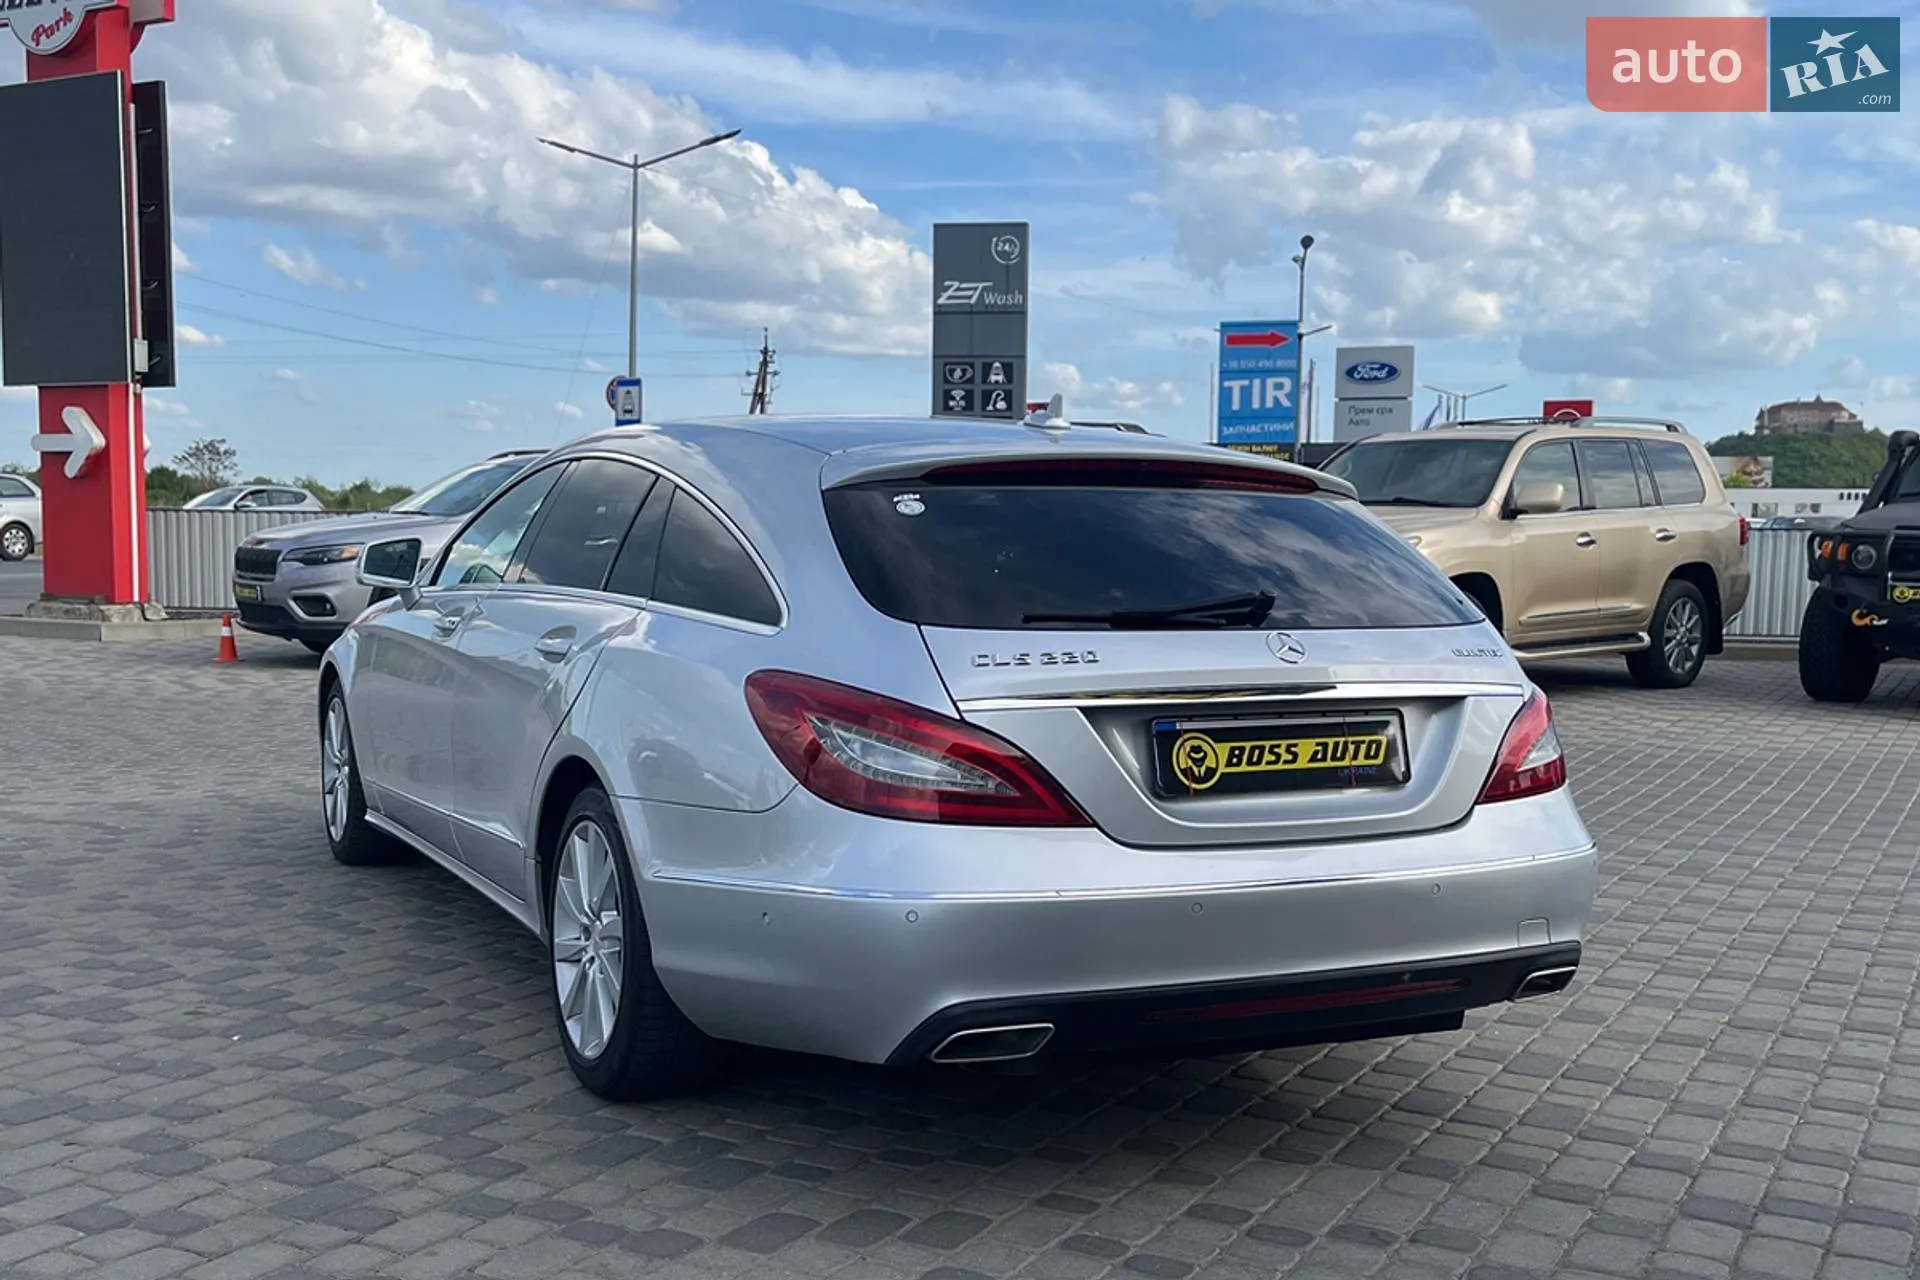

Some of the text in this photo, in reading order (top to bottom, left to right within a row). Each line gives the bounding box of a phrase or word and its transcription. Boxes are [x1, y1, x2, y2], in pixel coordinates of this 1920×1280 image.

[31, 7, 73, 47] Park
[937, 281, 1023, 305] ZET Wash
[1354, 363, 1389, 379] Ford
[1223, 376, 1292, 411] TIR
[1222, 422, 1294, 436] ЗАПЧАСТИНИ
[971, 650, 1100, 668] CLS 220
[1224, 739, 1382, 768] BOSS AUTO
